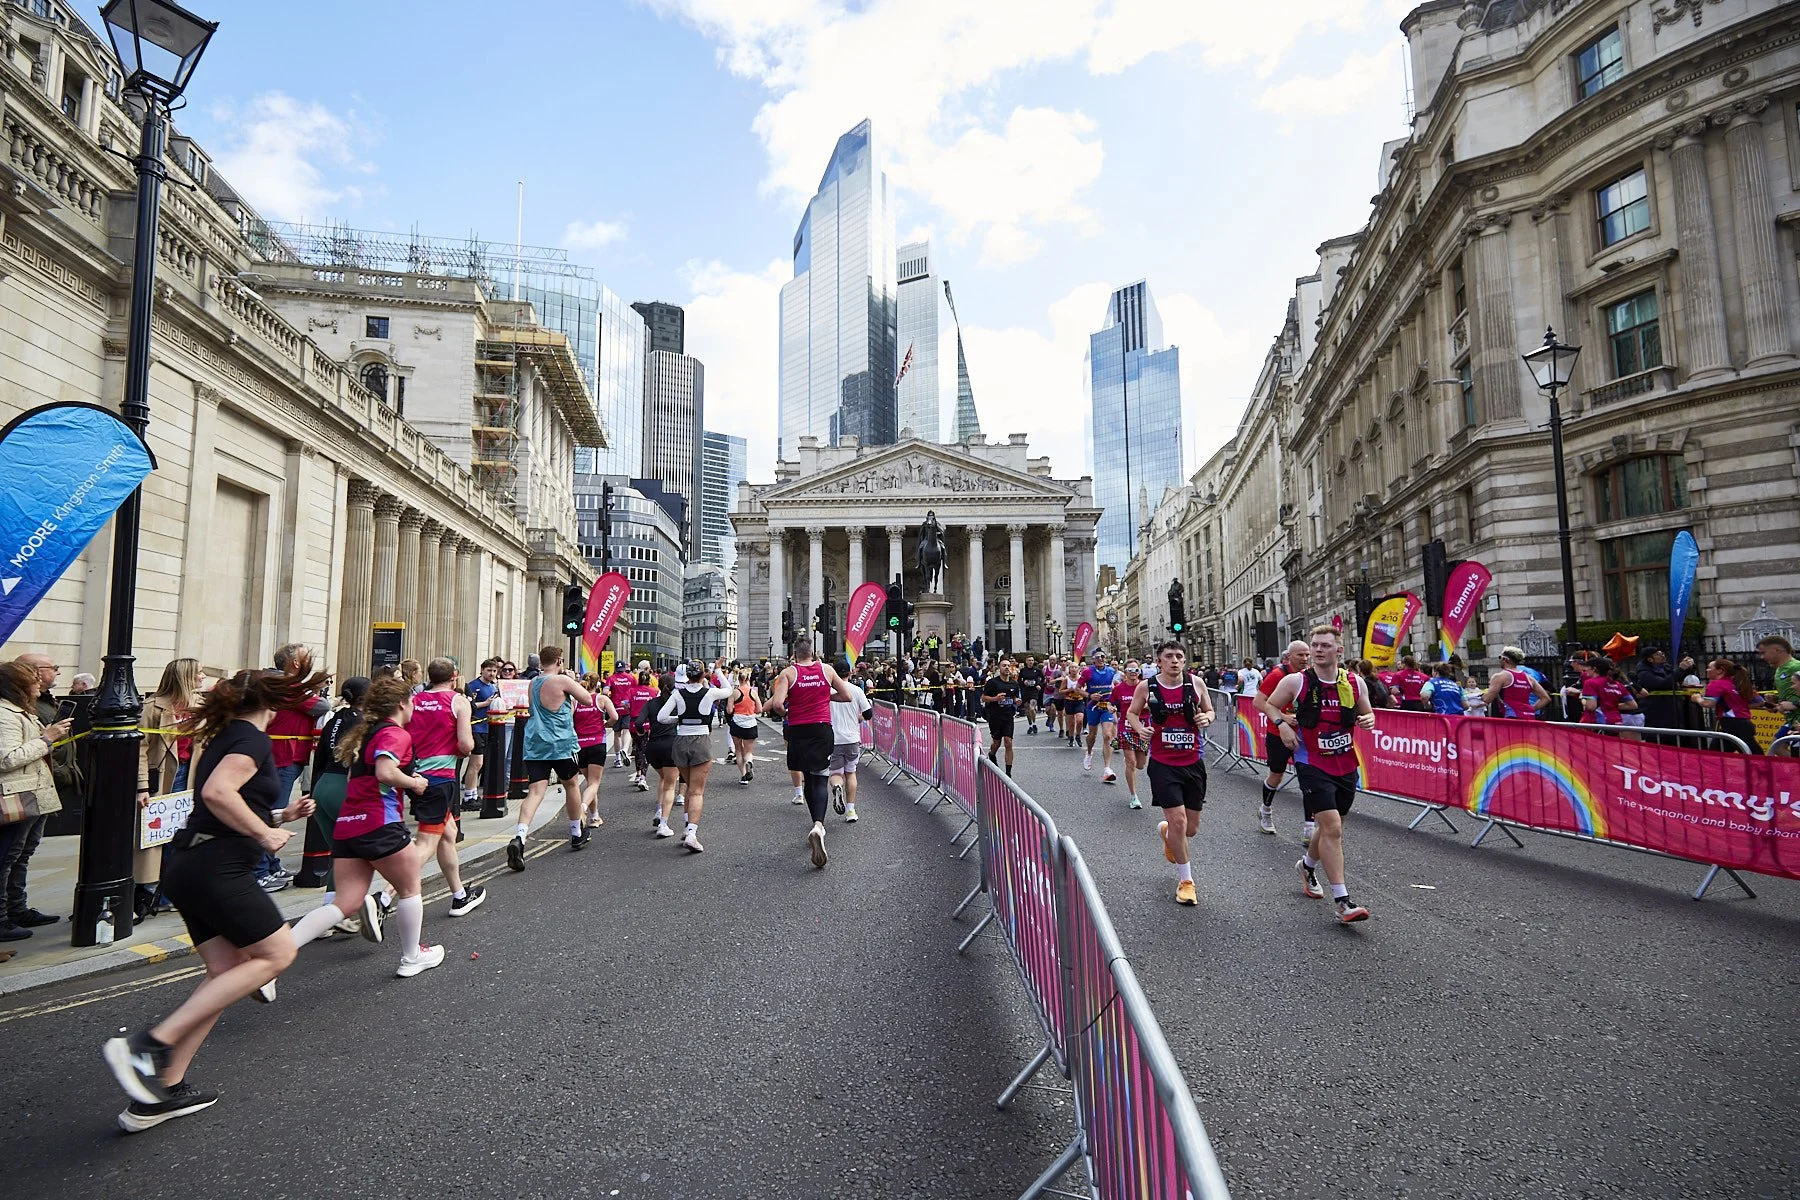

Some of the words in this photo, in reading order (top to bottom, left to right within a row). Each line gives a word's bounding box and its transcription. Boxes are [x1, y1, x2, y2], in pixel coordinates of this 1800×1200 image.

[10, 519, 58, 568] MOORE
[52, 473, 100, 521] Kingston
[95, 444, 126, 474] Smith
[1449, 573, 1479, 619] Tommy's
[590, 585, 620, 633] Tommy's
[852, 592, 877, 632] Tommy's
[798, 680, 825, 688] Tommy's
[415, 704, 443, 712] Tommy's
[1165, 734, 1193, 743] 10966
[1322, 735, 1349, 748] 10957
[1372, 730, 1458, 763] Tommy's
[1421, 765, 1437, 774] baby
[149, 802, 167, 816] GO
[175, 798, 191, 810] ON
[171, 809, 191, 822] FIT
[1617, 797, 1637, 808] The
[1702, 817, 1726, 828] and
[1729, 821, 1763, 836] baby
